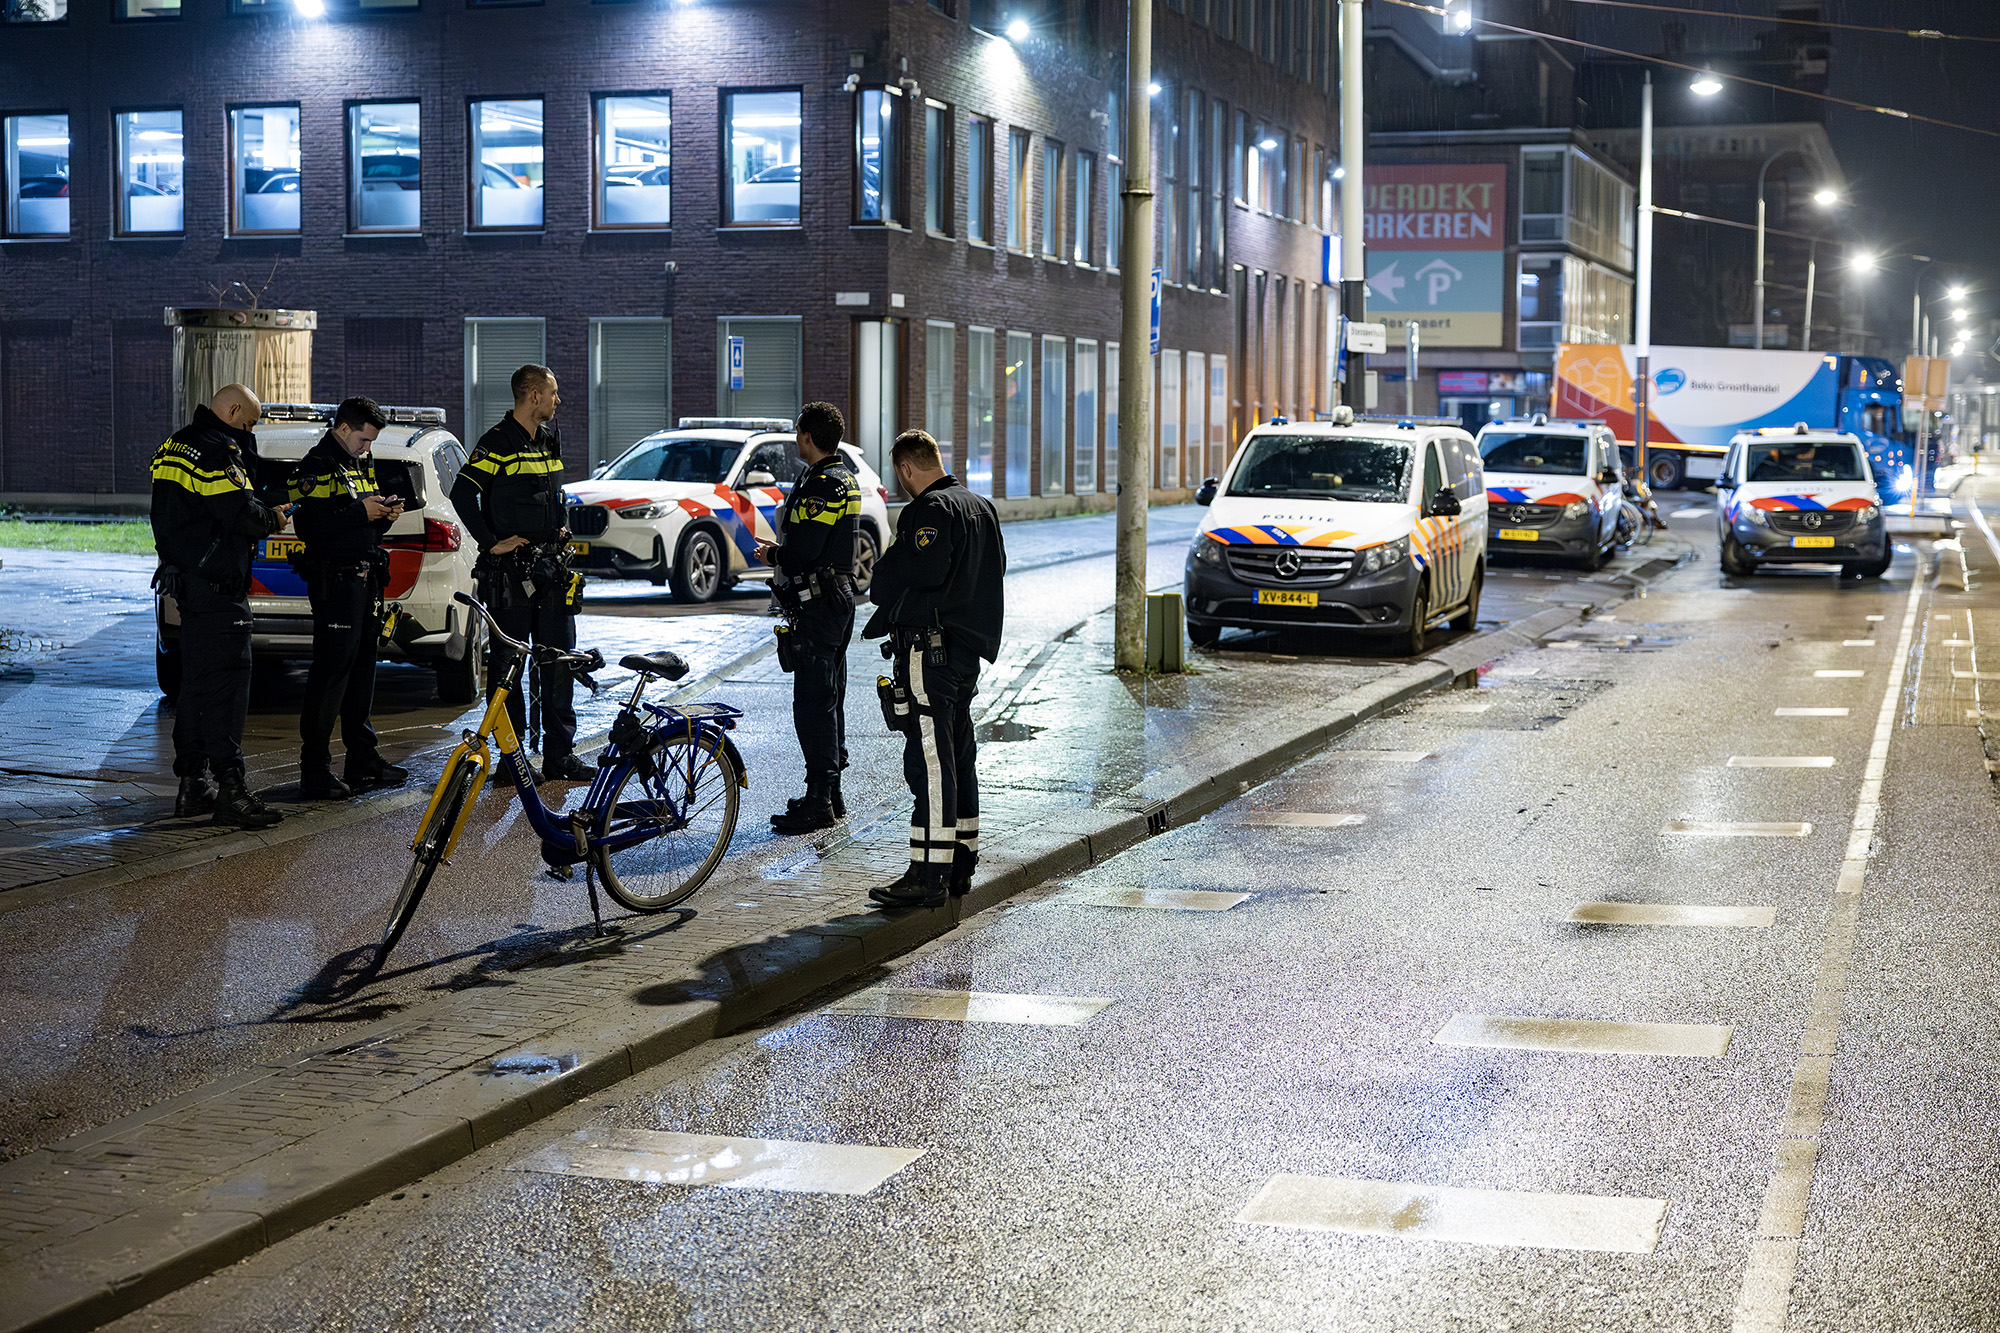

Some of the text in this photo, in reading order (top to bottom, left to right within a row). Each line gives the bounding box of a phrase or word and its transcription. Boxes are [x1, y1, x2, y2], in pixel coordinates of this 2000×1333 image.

[1364, 183, 1494, 210] VERDEKT
[1364, 211, 1492, 239] ARKEREN
[1428, 273, 1451, 305] P
[1262, 514, 1335, 523] POLITIE
[1262, 591, 1313, 605] XV-844-L
